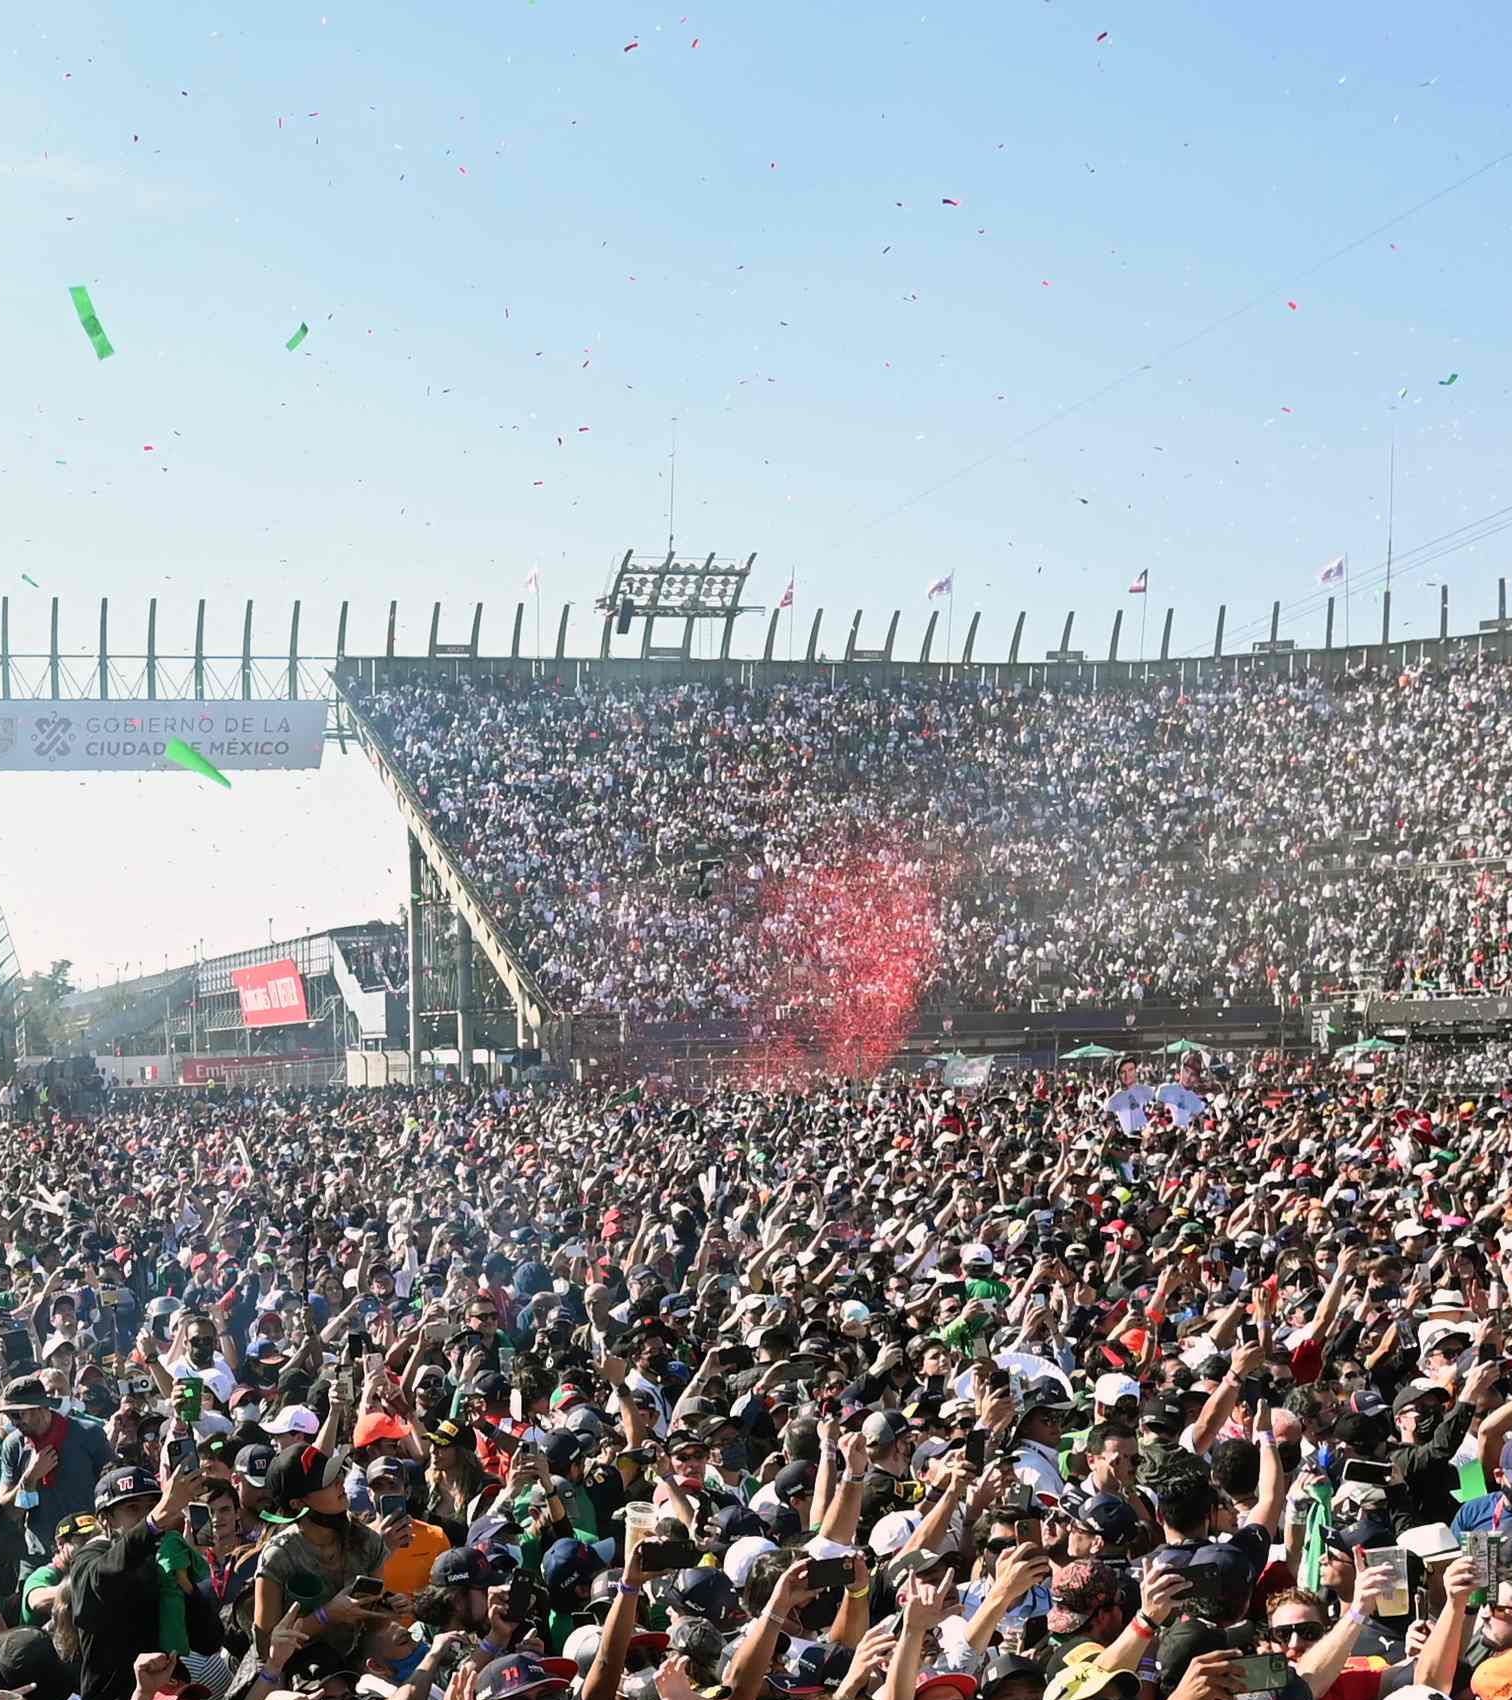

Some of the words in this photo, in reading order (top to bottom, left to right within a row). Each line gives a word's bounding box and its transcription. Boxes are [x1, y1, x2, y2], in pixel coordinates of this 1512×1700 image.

[85, 716, 216, 734] GOBIERNO
[224, 716, 254, 733] DE
[263, 716, 291, 733] LA
[85, 742, 166, 756] CIUDAD
[208, 738, 290, 756] MÉXICO
